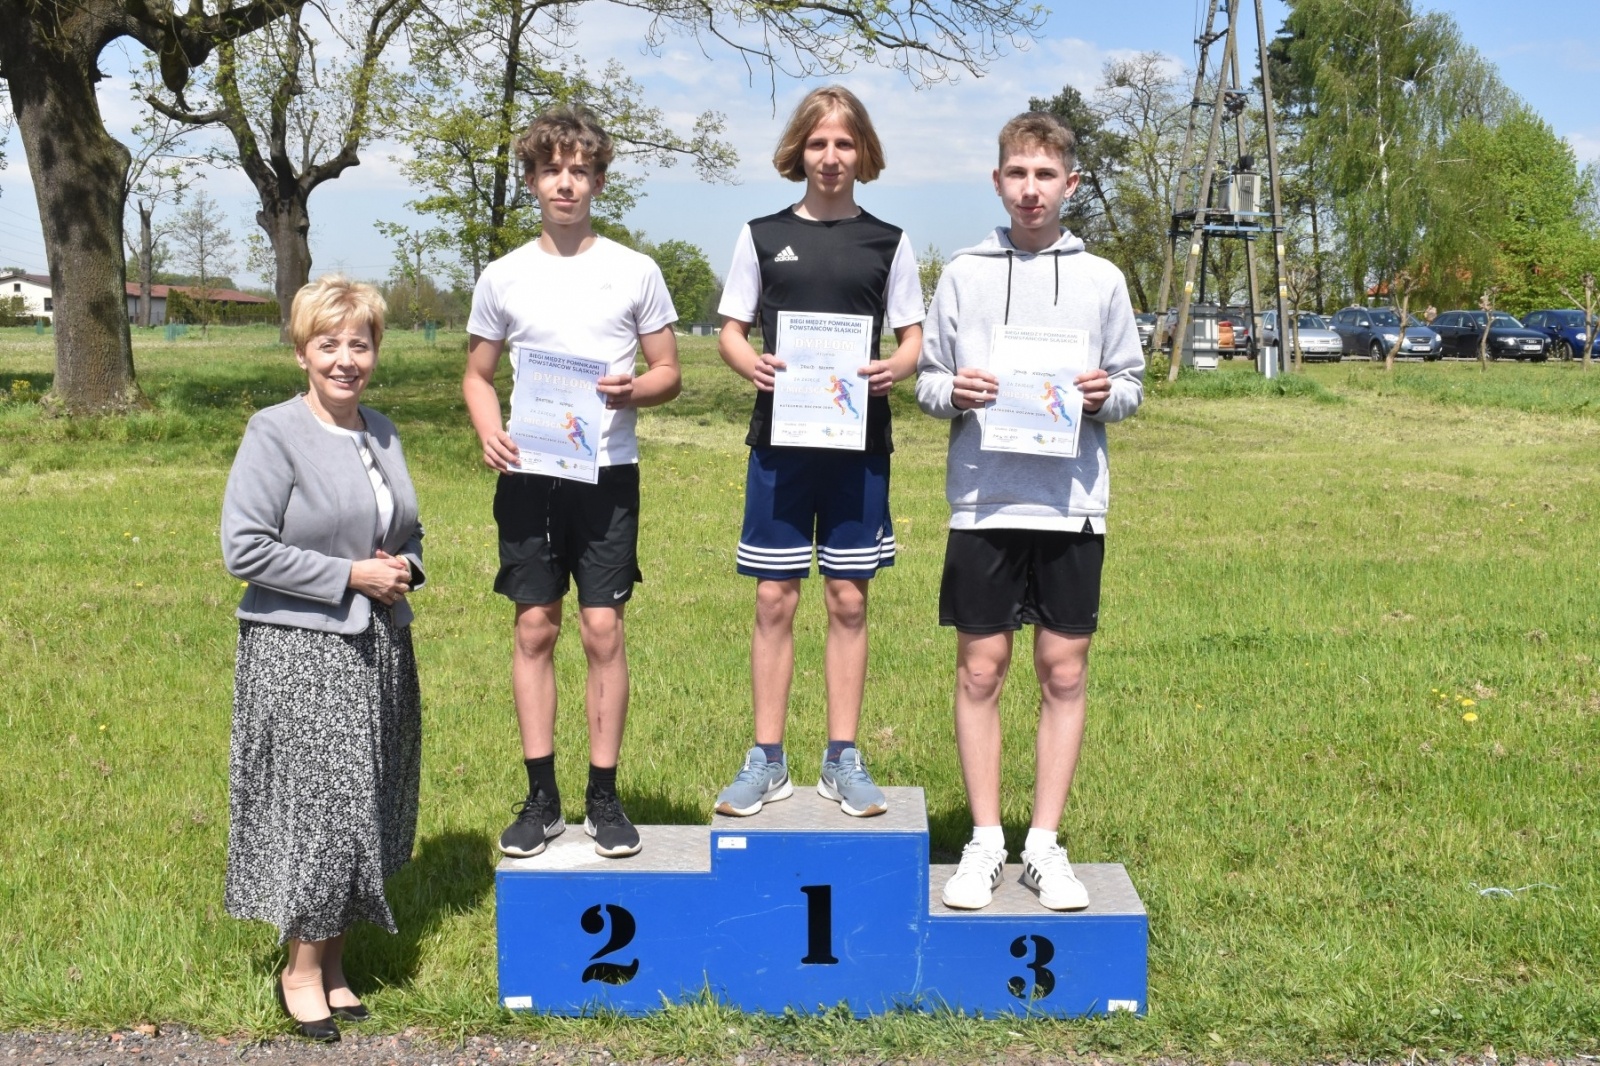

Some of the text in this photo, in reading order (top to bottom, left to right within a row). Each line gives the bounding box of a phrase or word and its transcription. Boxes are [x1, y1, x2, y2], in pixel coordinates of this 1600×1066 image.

[828, 320, 862, 328] POMNIKAMI
[795, 338, 857, 351] DYPLOM
[566, 359, 600, 370] POMNIKAMI
[533, 371, 593, 390] DYPLOM
[799, 884, 839, 965] 1
[579, 902, 640, 985] 2
[1006, 934, 1057, 999] 3
